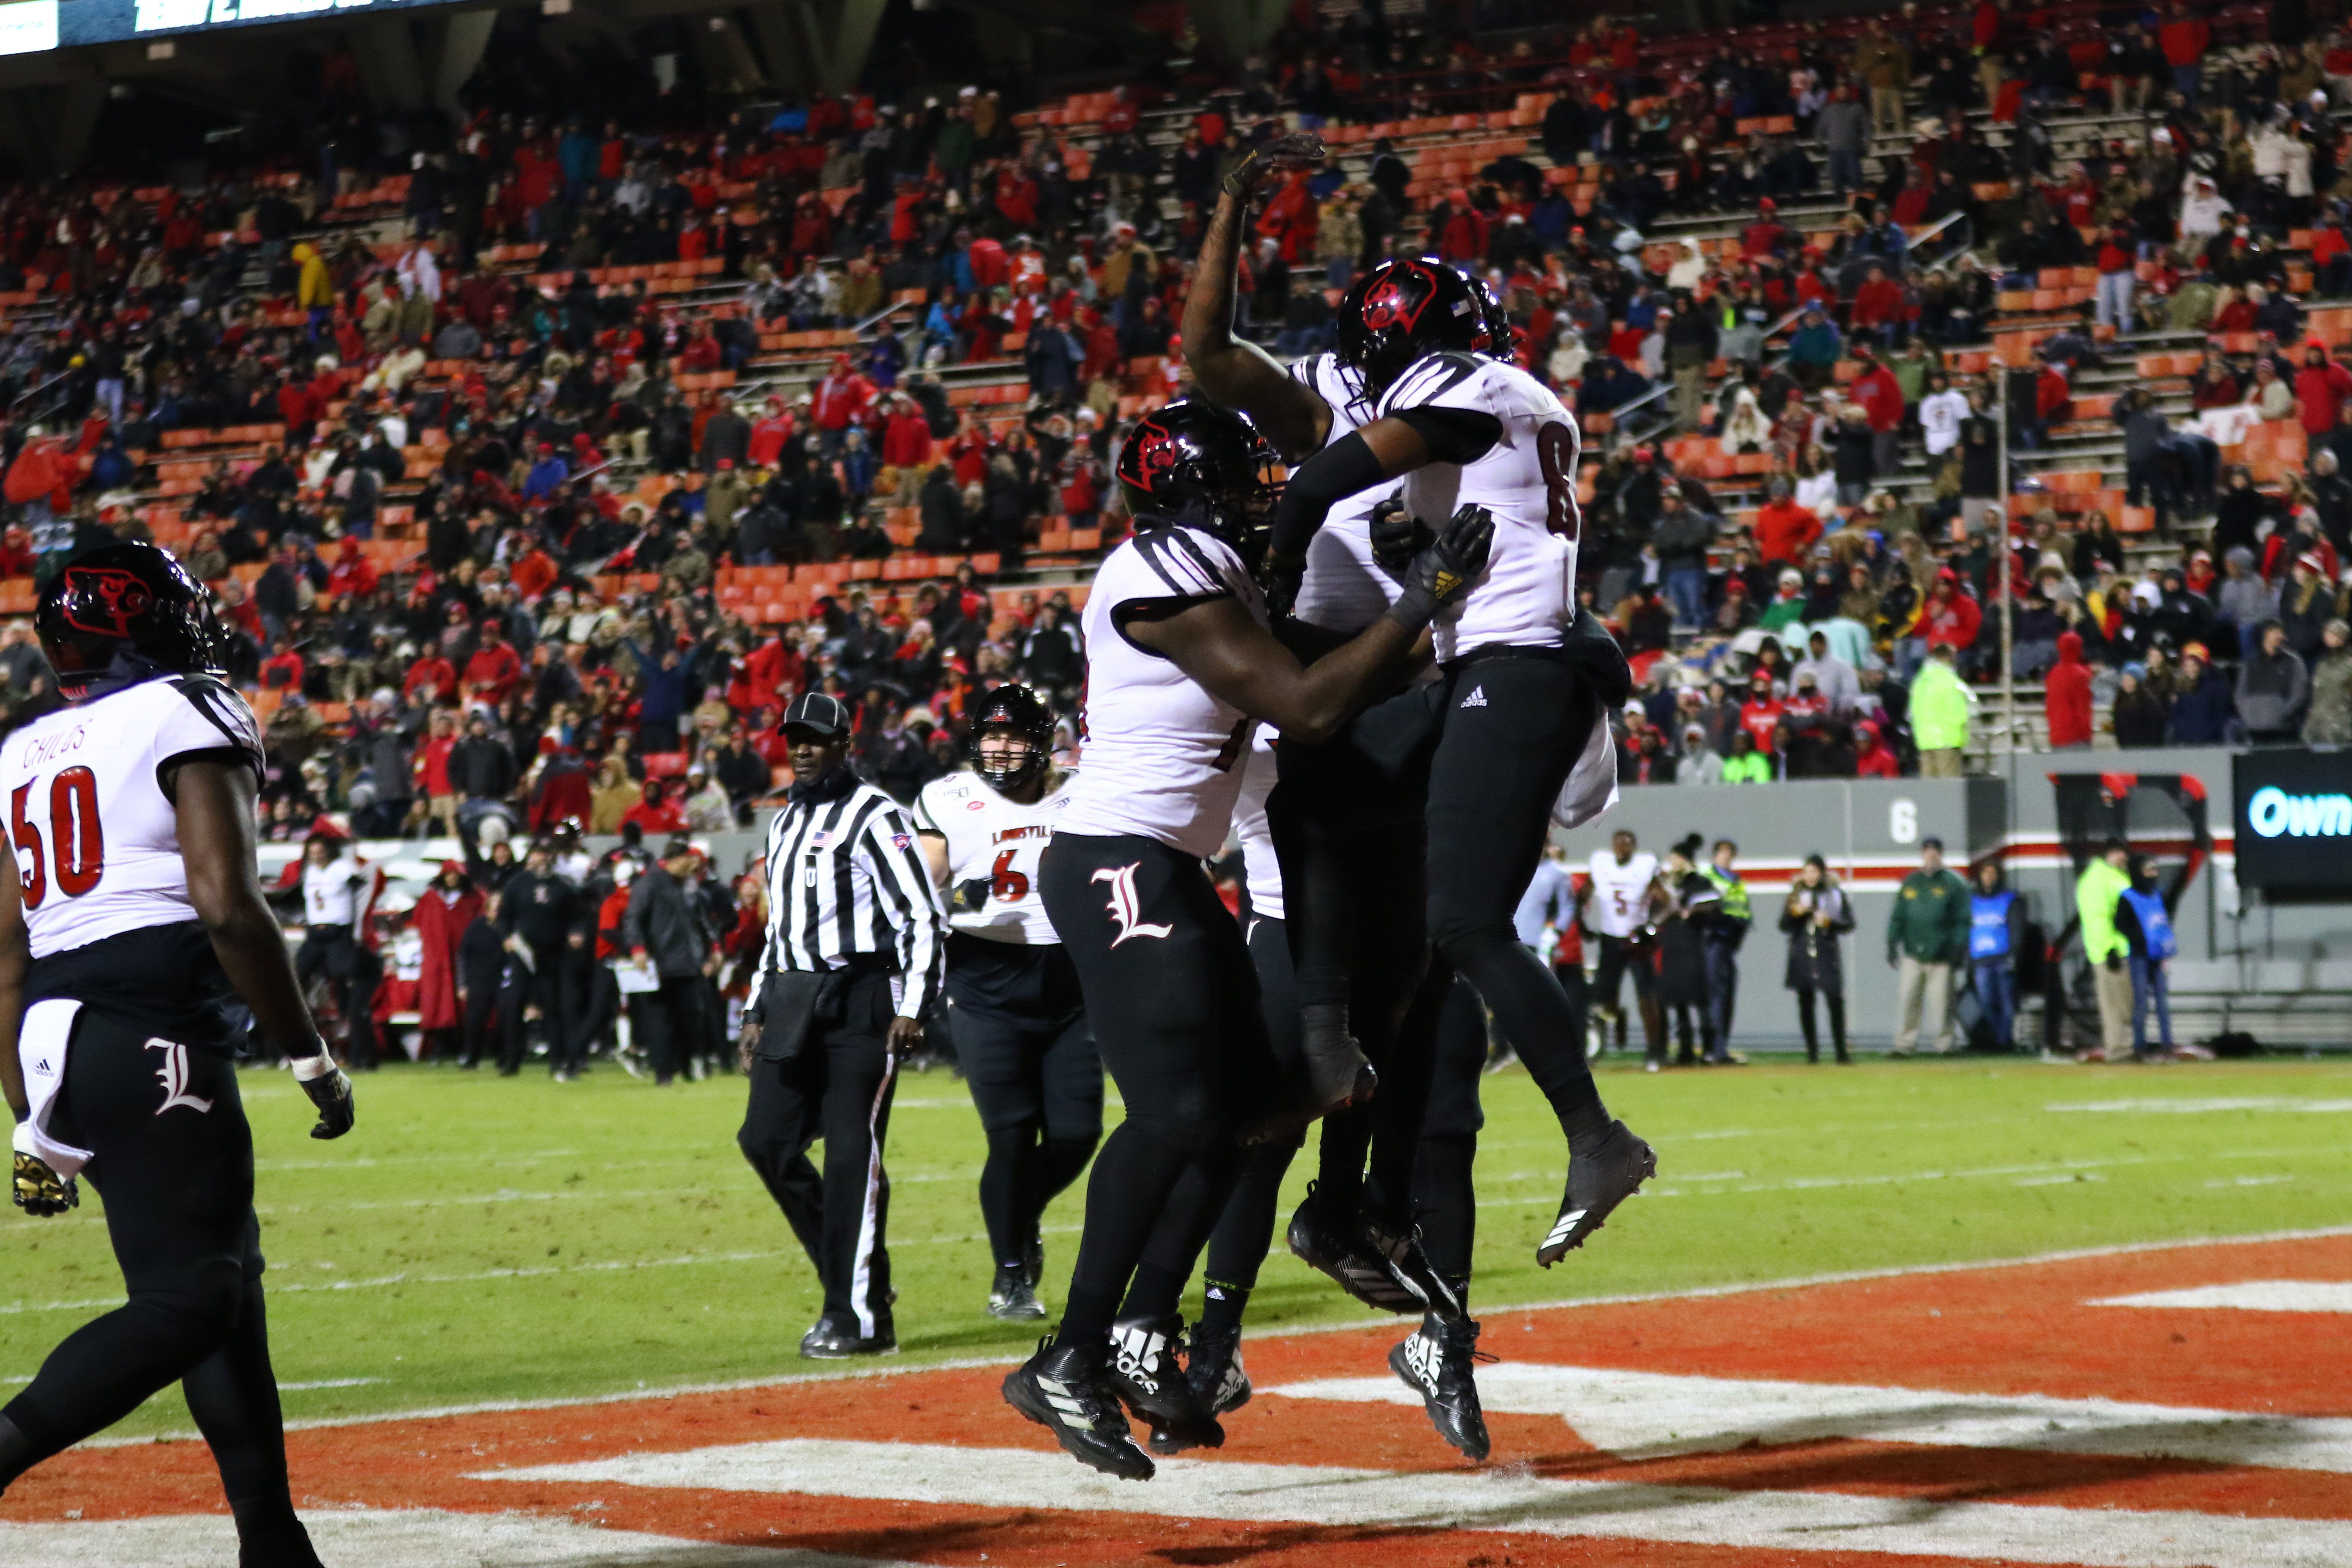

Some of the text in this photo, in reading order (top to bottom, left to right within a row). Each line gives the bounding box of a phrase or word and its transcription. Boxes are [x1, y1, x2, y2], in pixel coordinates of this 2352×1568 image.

[1461, 699, 1487, 708] adidas
[24, 719, 93, 769] CHILDS
[1891, 801, 1917, 843] 6
[2248, 786, 2352, 838] Own
[11, 765, 104, 911] 50
[805, 868, 817, 888] U
[1090, 861, 1173, 949] L
[1614, 890, 1627, 917] 5
[144, 1037, 214, 1115] L
